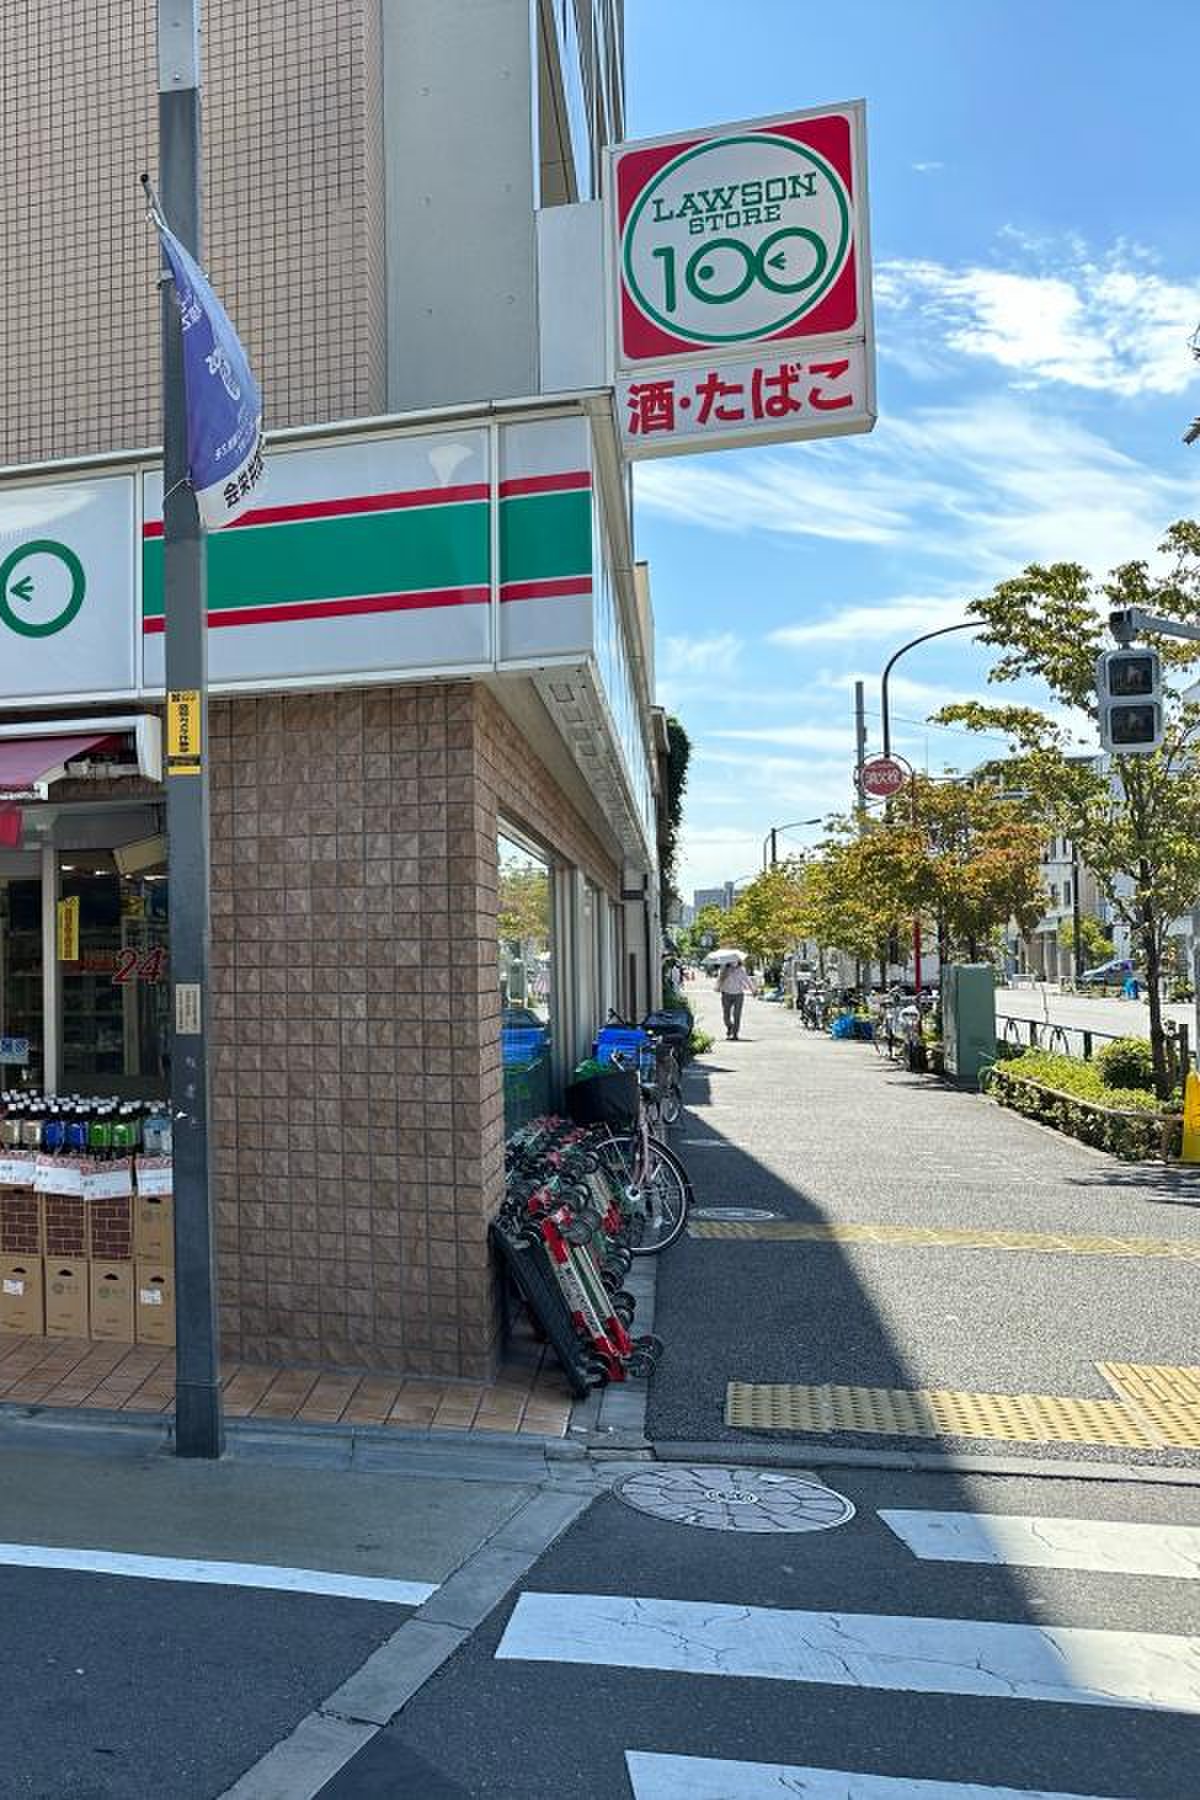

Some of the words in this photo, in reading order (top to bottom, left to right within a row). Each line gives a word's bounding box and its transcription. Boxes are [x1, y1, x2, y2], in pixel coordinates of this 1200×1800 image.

[653, 172, 817, 222] LAWSON
[689, 204, 781, 235] STORE
[652, 227, 828, 312] 100
[628, 360, 852, 434] 酒・たばこ
